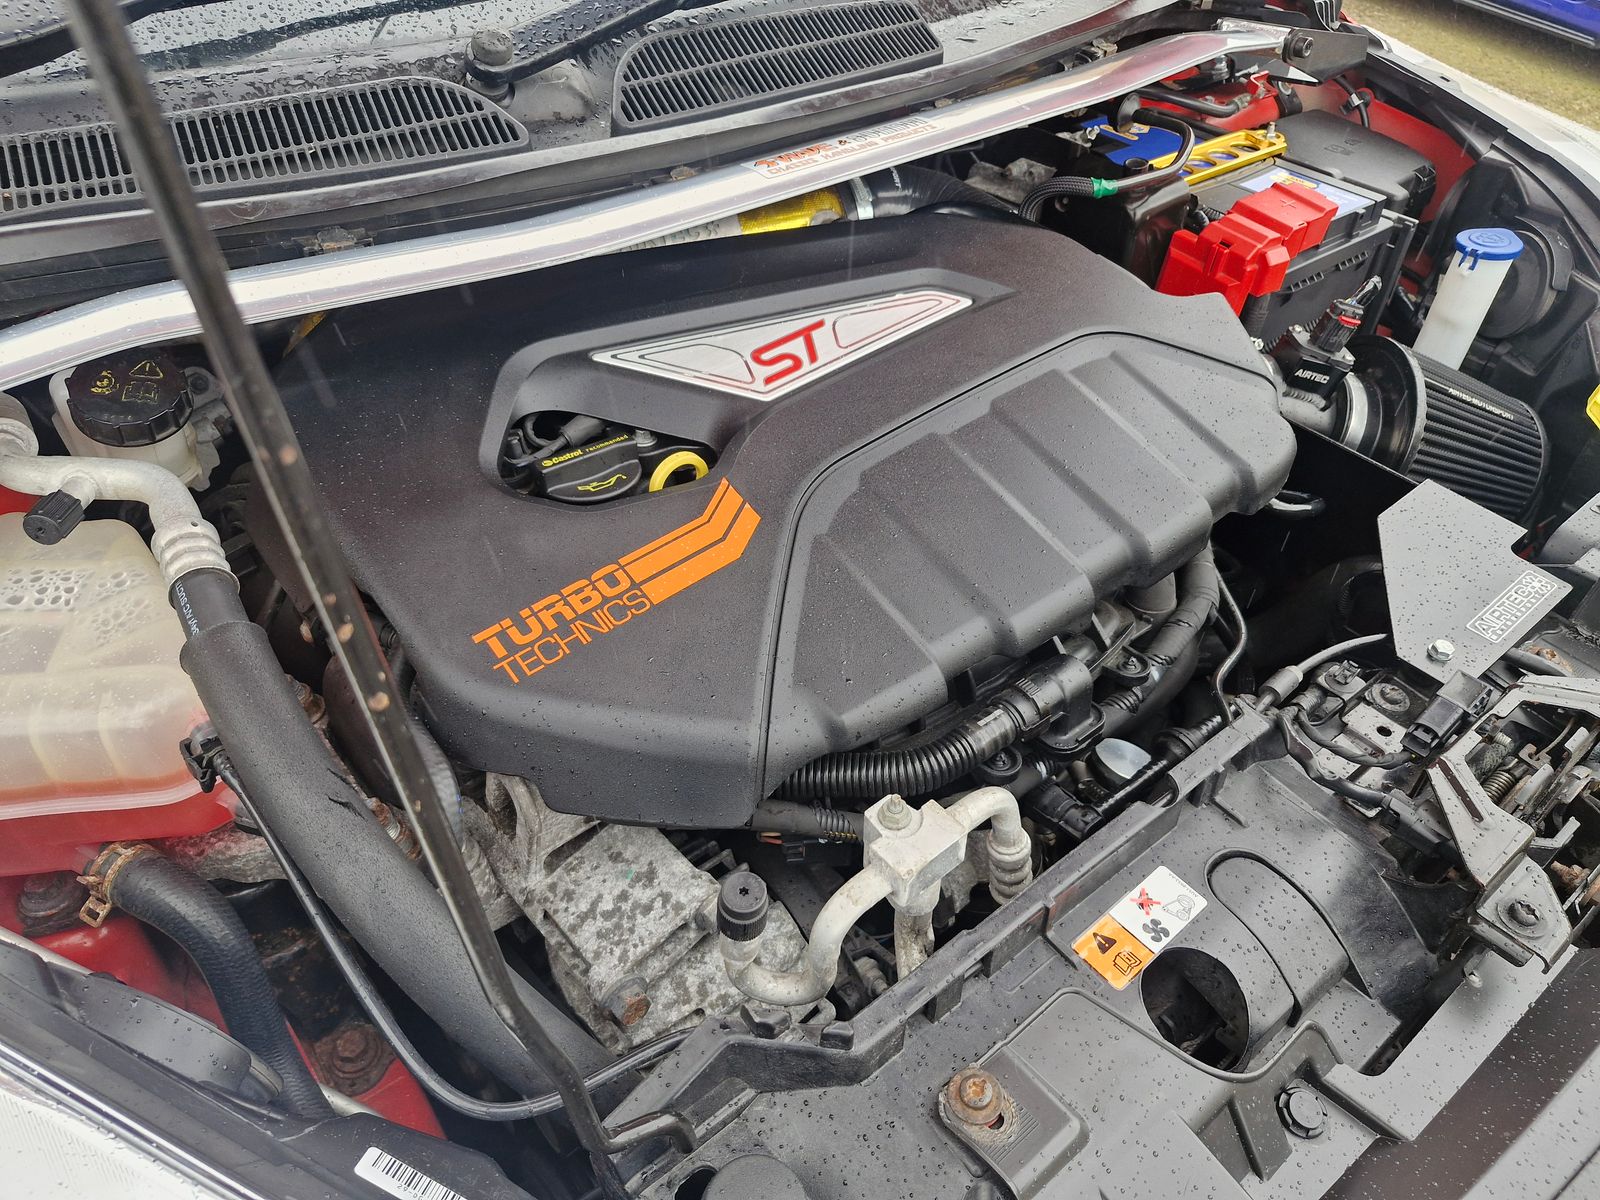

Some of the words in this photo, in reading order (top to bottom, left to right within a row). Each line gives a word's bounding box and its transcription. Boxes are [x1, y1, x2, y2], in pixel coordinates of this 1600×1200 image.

[880, 123, 938, 143] PRODUCTS
[751, 319, 826, 387] ST
[1294, 368, 1330, 384] AIRTEC
[552, 449, 584, 464] Castrol
[472, 563, 632, 659] TURBO
[493, 588, 651, 684] TECHNICS
[1475, 584, 1535, 637] AIRTEC
